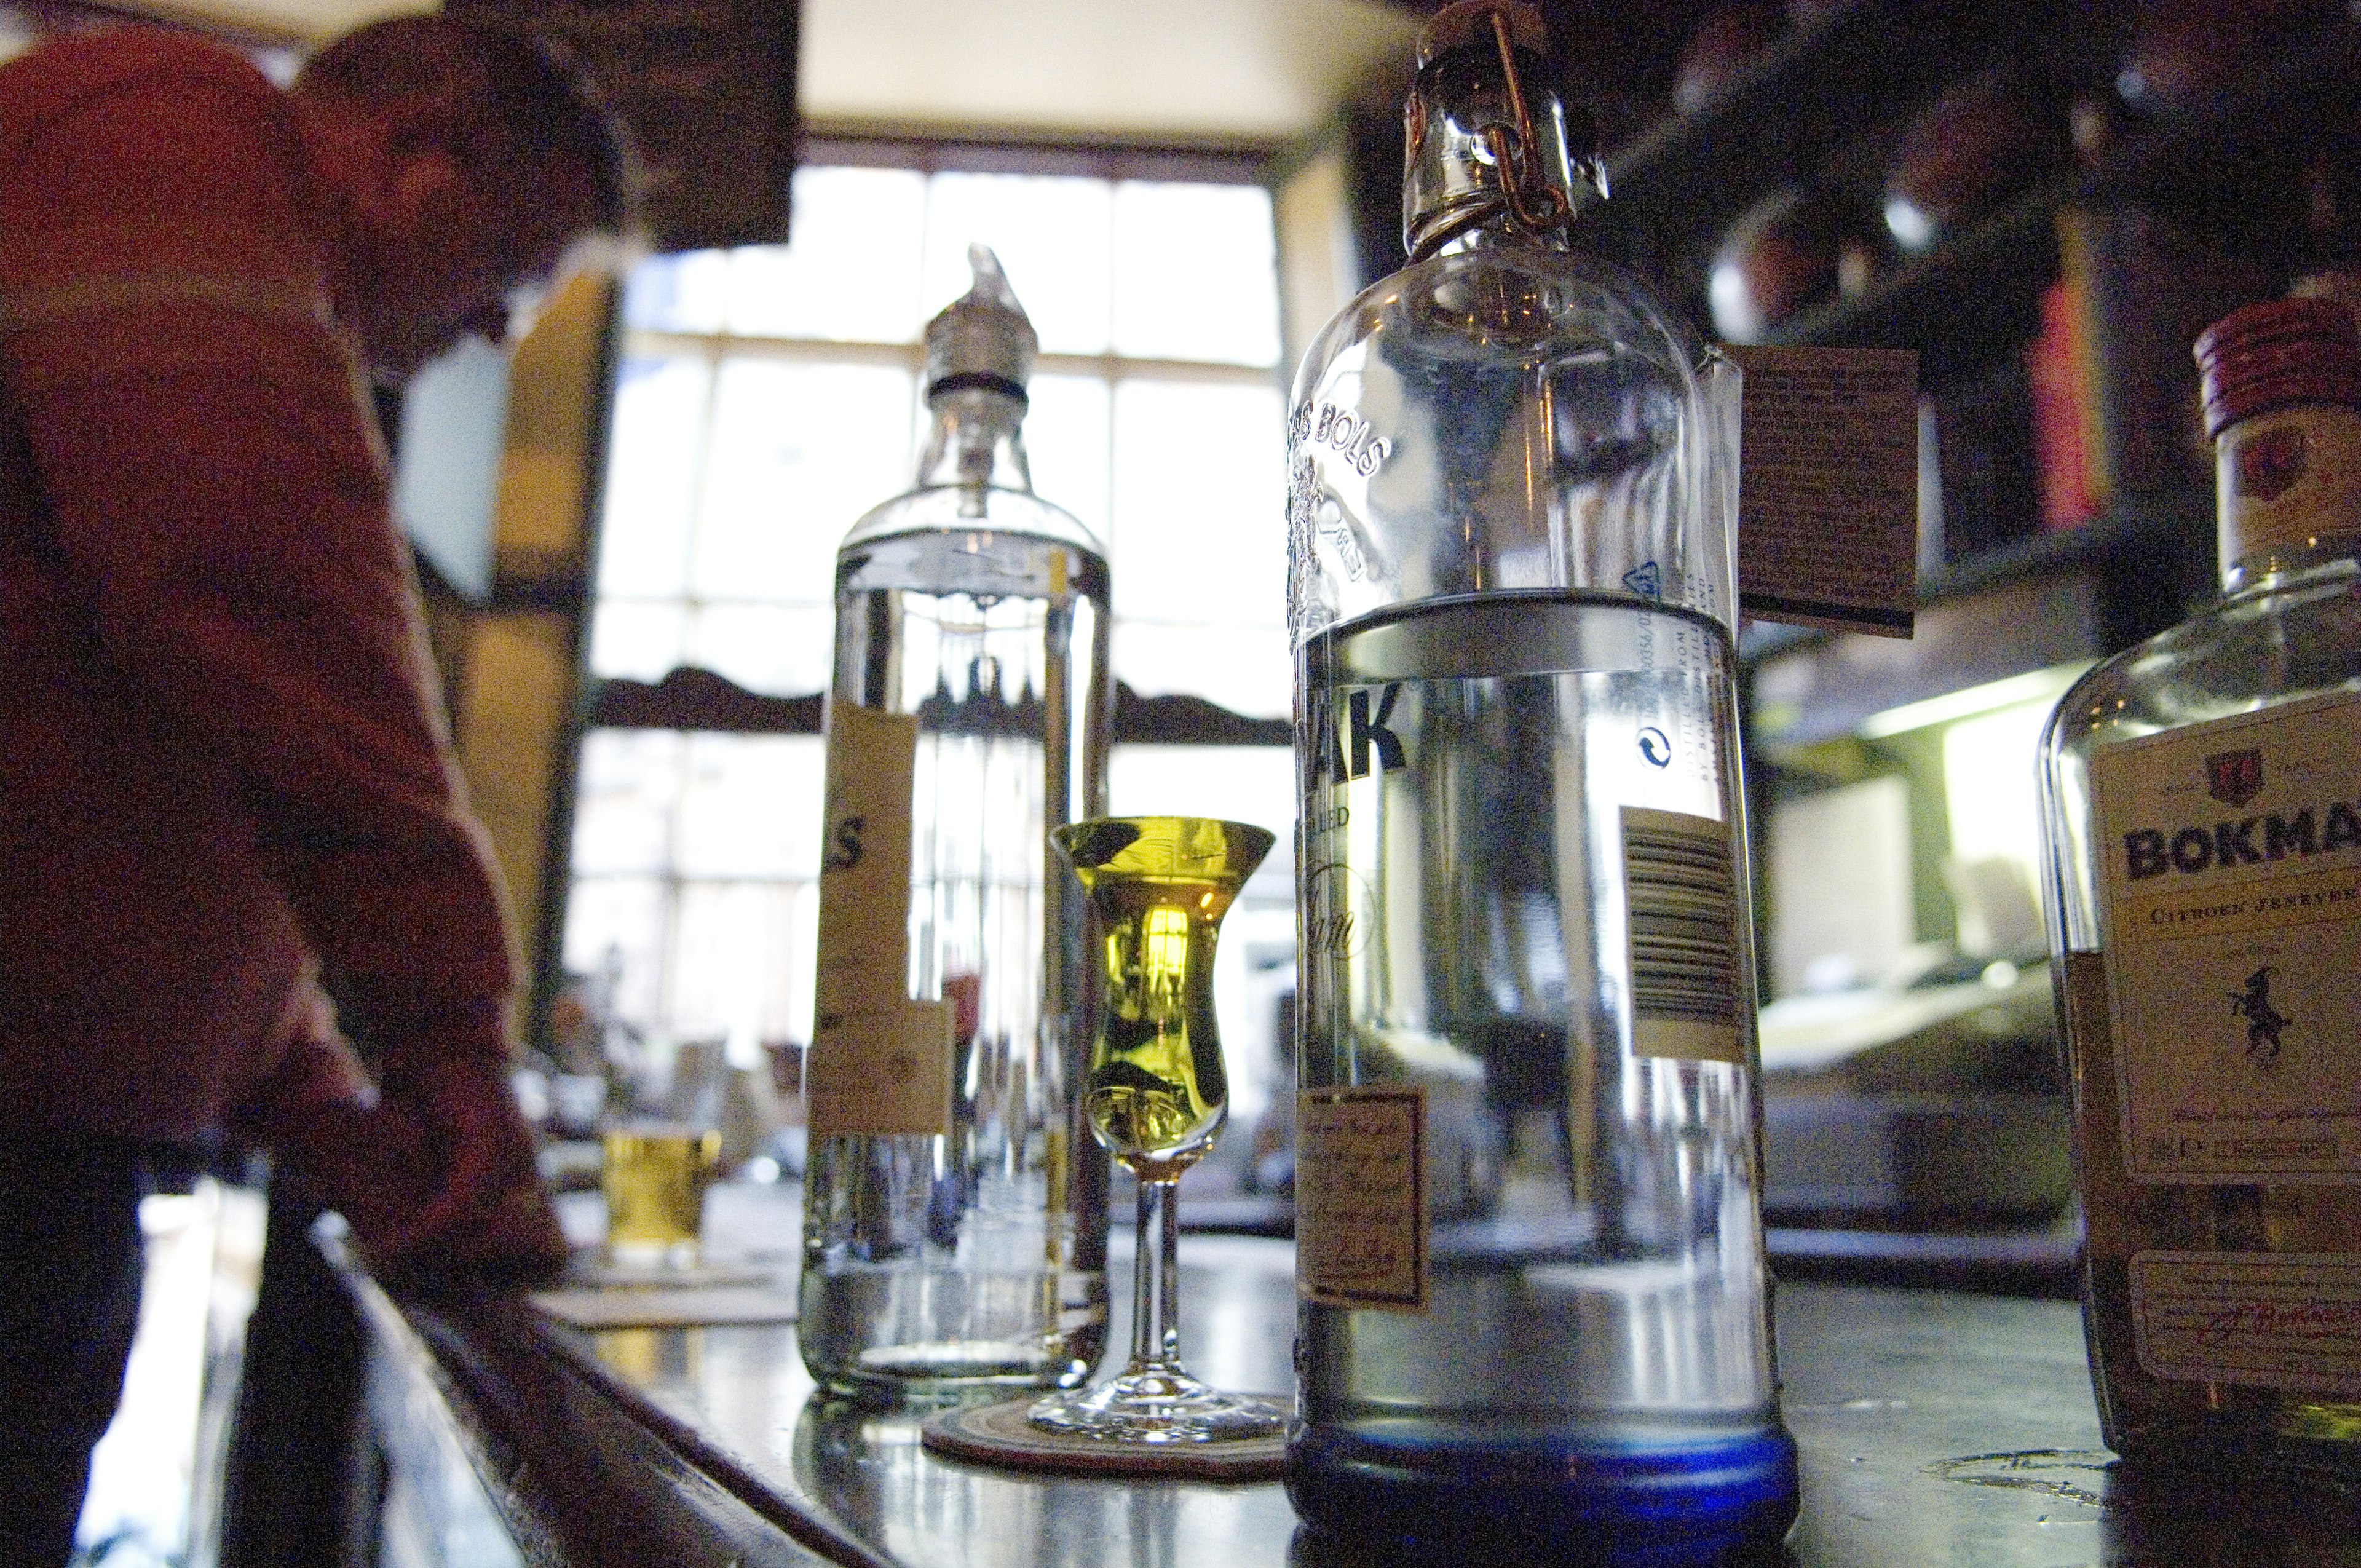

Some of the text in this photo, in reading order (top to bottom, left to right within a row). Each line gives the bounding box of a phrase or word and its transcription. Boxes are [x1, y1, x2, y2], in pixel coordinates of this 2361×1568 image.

[1315, 402, 1392, 477] BOLS
[1677, 632, 1695, 778] DISTILLED FROM
[1699, 764, 1709, 782] BY
[2122, 801, 2361, 882] BOKMA
[2150, 887, 2357, 925] CITROEN JENEVER
